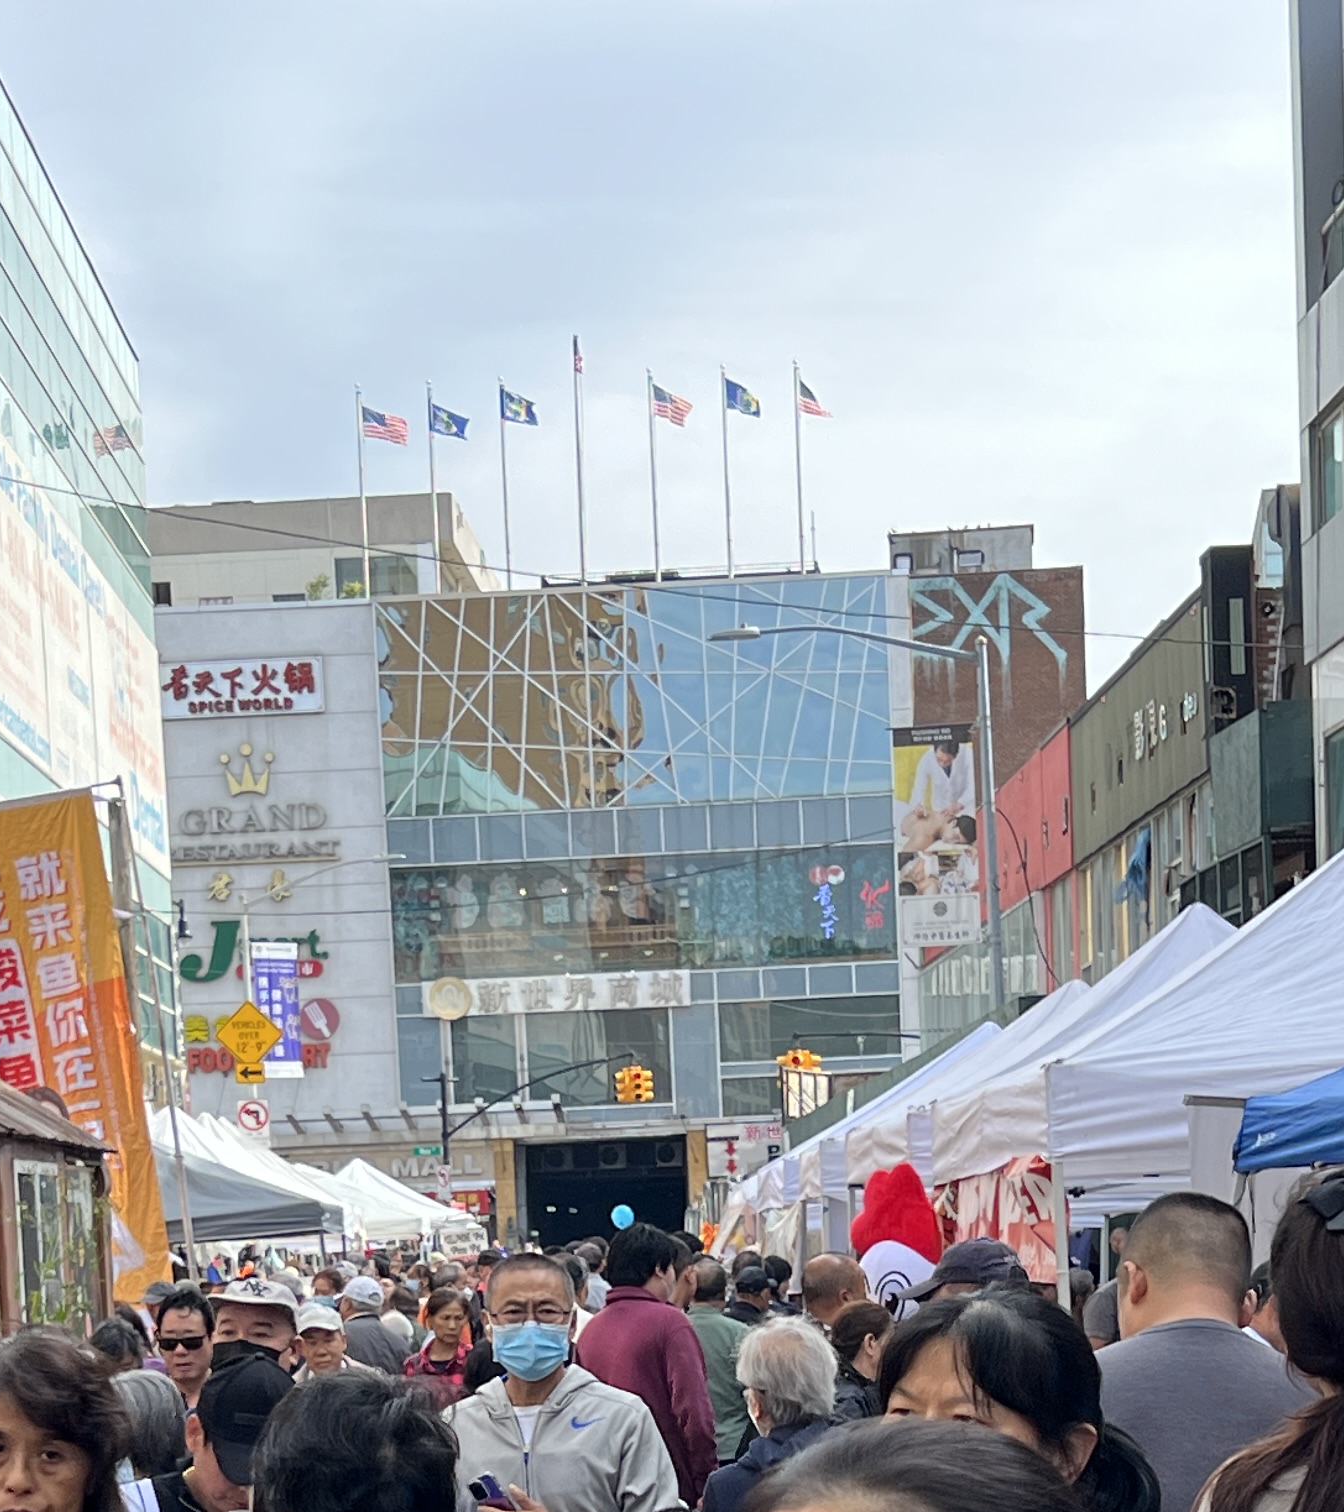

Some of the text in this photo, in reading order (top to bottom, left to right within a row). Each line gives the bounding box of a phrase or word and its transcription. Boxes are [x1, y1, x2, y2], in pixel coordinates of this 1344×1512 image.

[188, 697, 293, 714] SPICE WORLD
[179, 803, 327, 836] GRAND
[477, 972, 684, 1014] 新世界商城
[231, 1020, 266, 1029] VEHICLES
[239, 1031, 259, 1040] OVER
